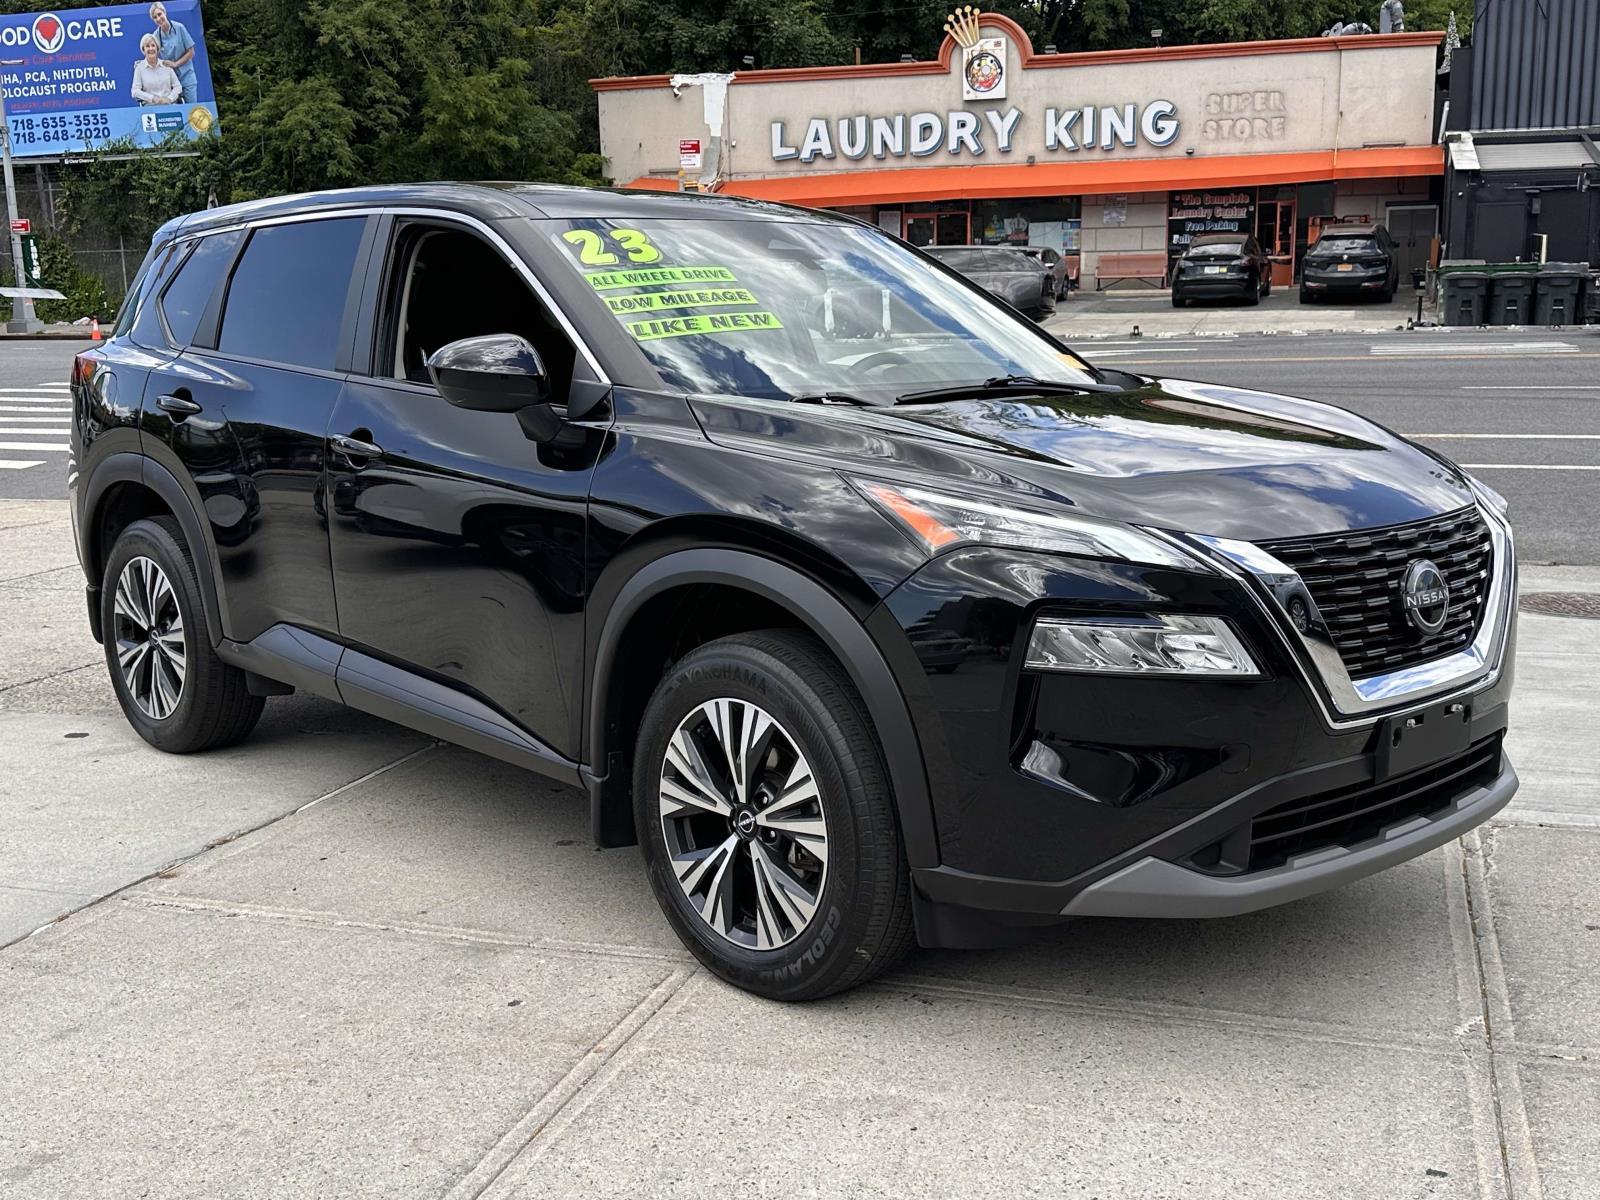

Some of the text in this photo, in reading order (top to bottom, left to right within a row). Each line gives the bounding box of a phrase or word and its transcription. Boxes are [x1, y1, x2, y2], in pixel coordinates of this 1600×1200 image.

[0, 17, 124, 46] OD CARE
[25, 71, 50, 82] PCA,
[60, 80, 116, 94] PROGRAM
[1204, 91, 1287, 115] SUPER
[12, 113, 108, 131] 718-635-3535
[770, 99, 1181, 162] LAUNDRY KING
[1202, 117, 1286, 140] STORE
[14, 127, 110, 144] 718-648-2020
[1203, 192, 1249, 206] Complete
[1172, 207, 1213, 219] Laundry
[1185, 220, 1239, 231] Free Parking
[562, 229, 664, 265] 23
[592, 269, 730, 287] ALL WHEEL DRIVE
[609, 291, 751, 312] LOW MILEAGE
[633, 314, 771, 337] LIKE NEW
[1407, 589, 1448, 606] NISSAN
[685, 663, 767, 695] YOKOHAMA
